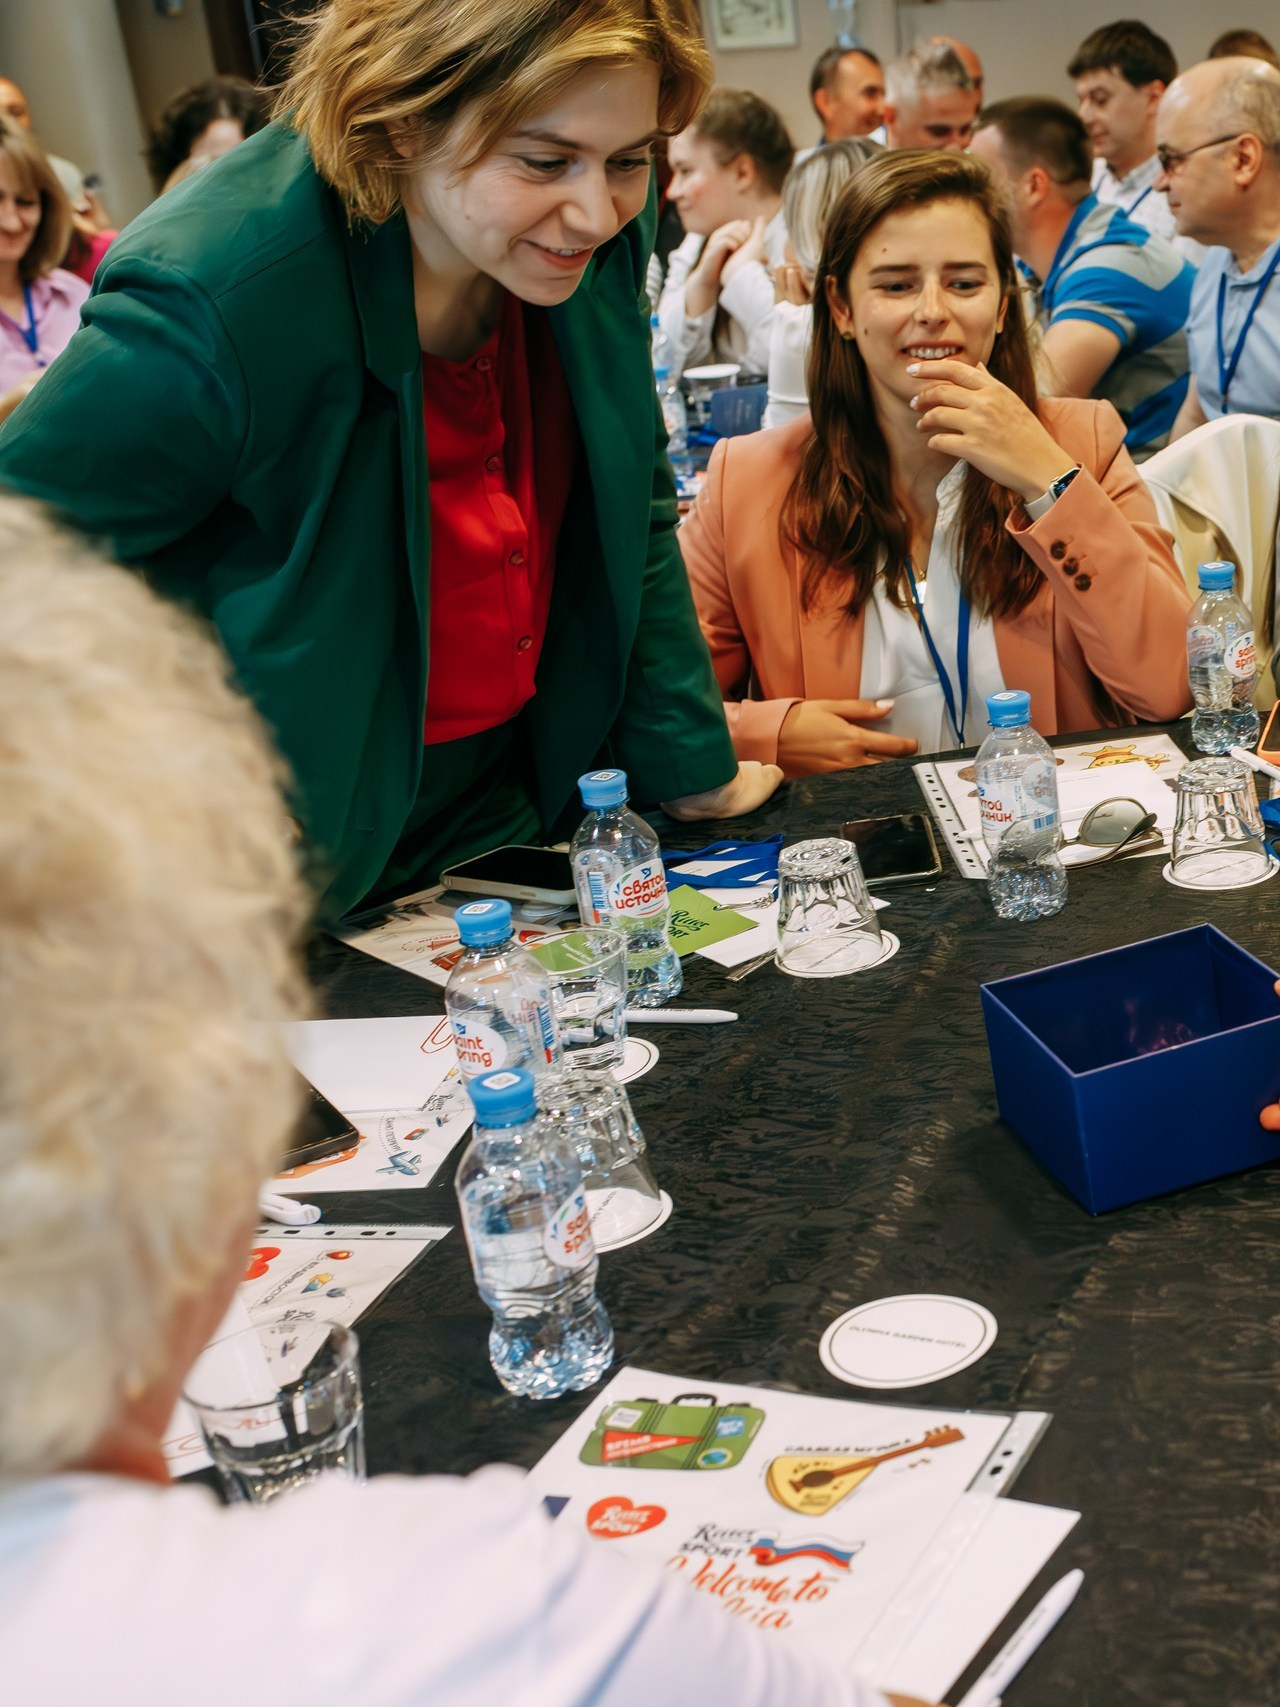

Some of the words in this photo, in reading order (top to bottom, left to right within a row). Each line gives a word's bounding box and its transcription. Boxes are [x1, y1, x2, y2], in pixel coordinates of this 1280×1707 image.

[671, 910, 710, 932] Ritter
[668, 926, 690, 938] ORT
[453, 1036, 484, 1050] aint
